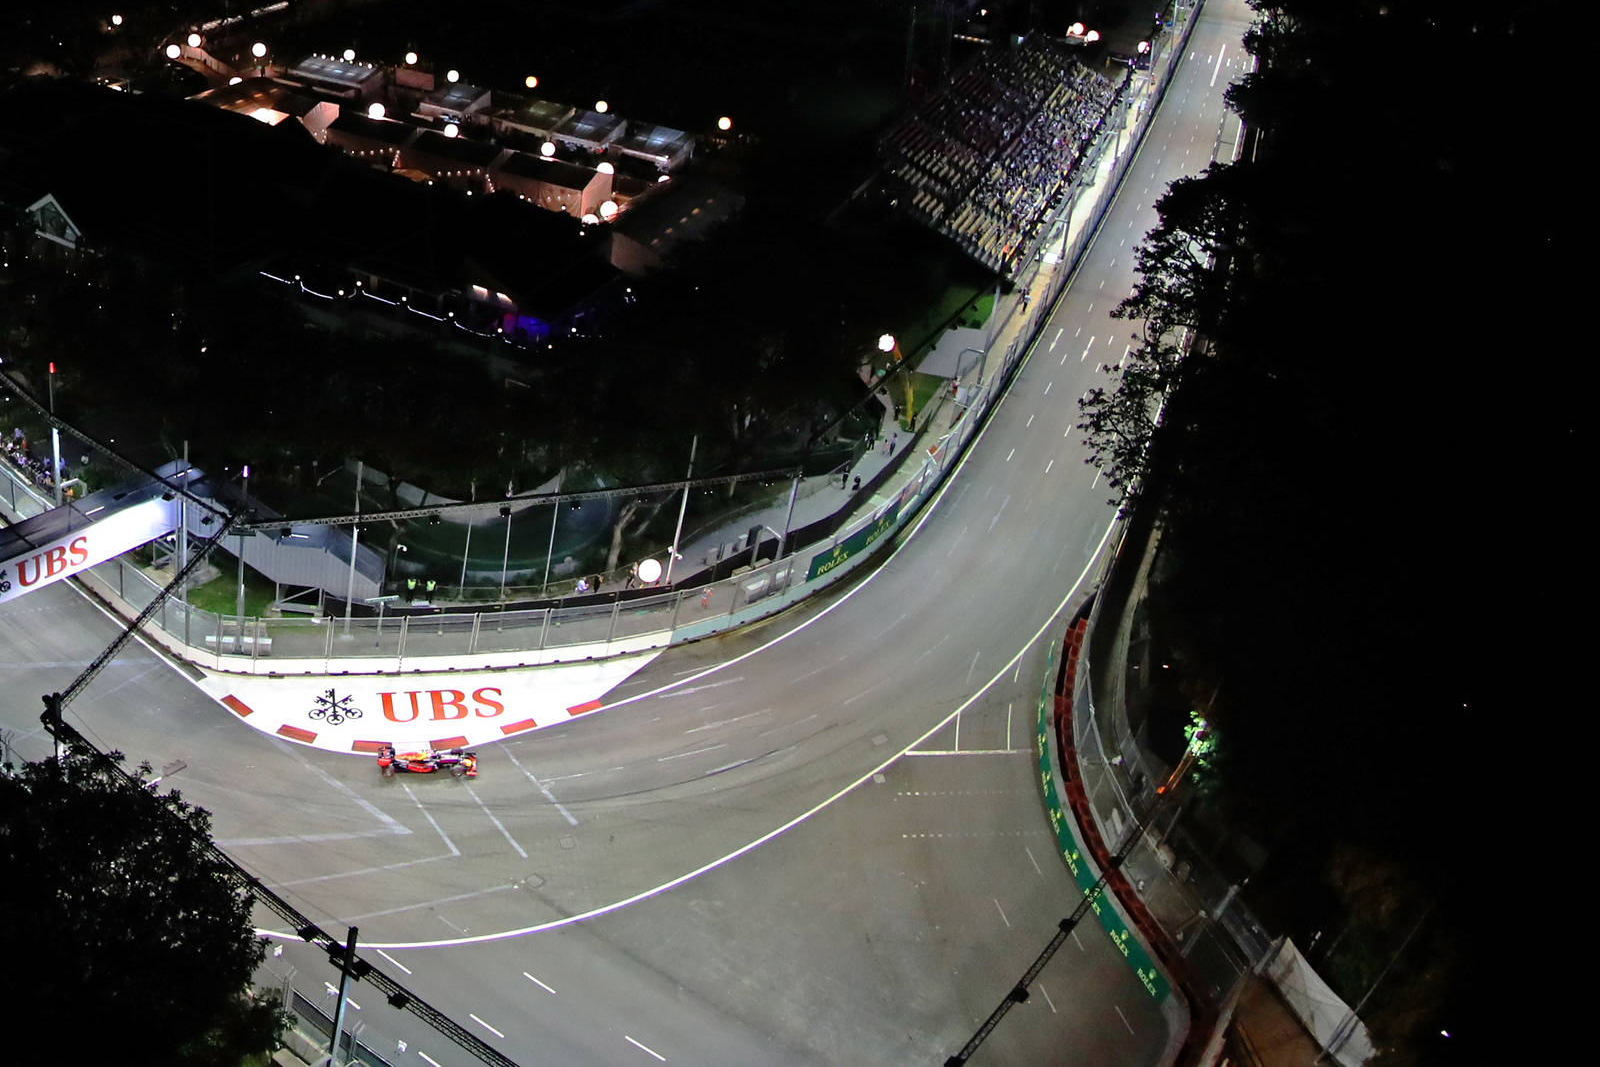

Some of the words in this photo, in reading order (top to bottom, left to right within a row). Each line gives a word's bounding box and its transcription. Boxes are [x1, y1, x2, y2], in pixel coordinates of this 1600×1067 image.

[15, 536, 89, 587] UBS
[817, 551, 849, 575] ROLEX
[376, 687, 505, 723] UBS
[1110, 929, 1129, 957] ROLEX
[1137, 967, 1156, 996] ROLEX
